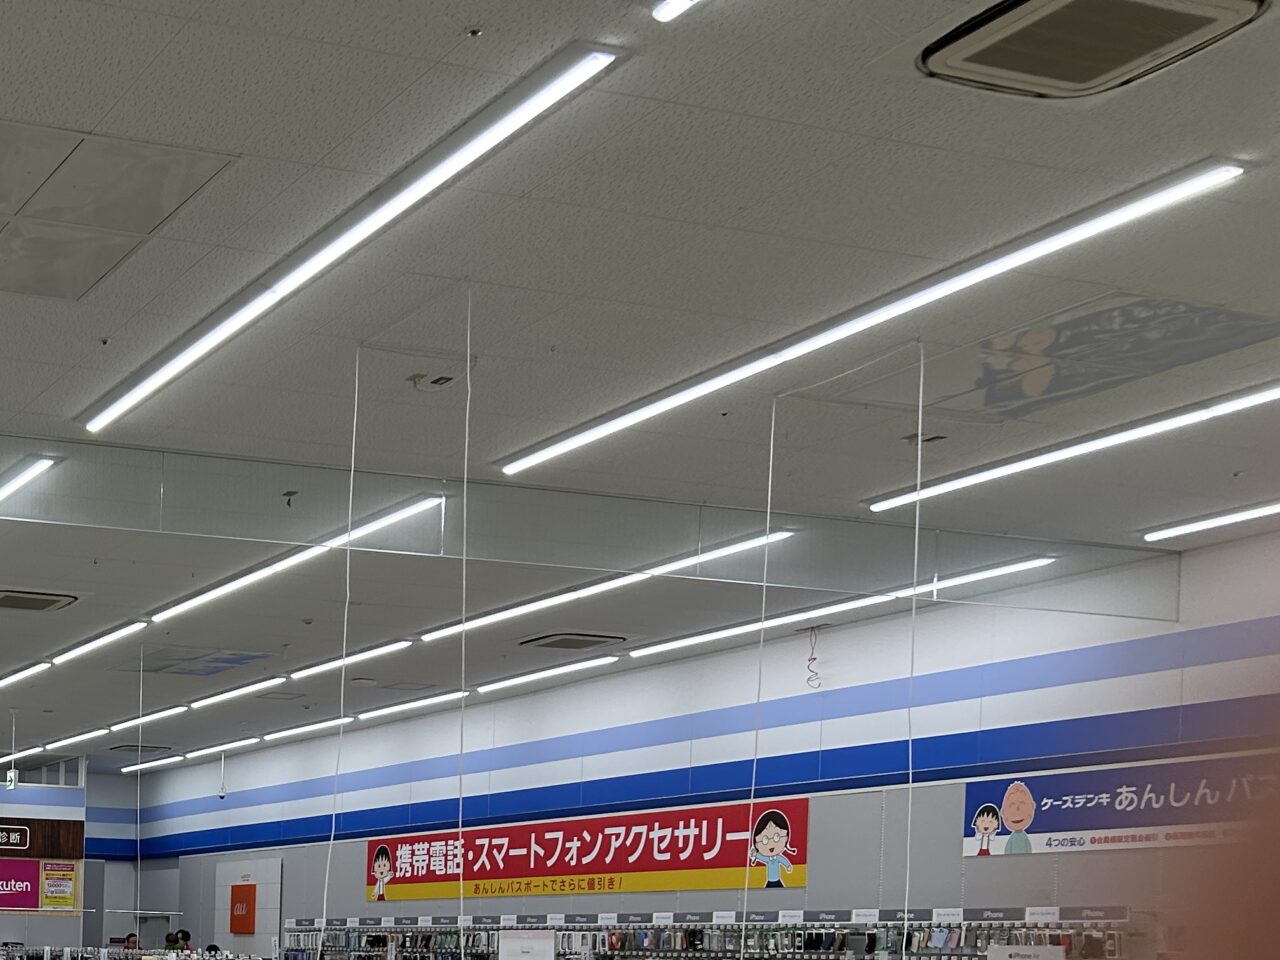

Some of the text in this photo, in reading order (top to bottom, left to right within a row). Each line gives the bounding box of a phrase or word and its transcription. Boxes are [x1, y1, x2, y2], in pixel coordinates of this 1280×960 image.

[1041, 792, 1110, 811] ケーズデンキ
[395, 816, 750, 878] 携帯電話・スマートフォンアクセサリー
[1045, 835, 1086, 848] 4つの安心
[233, 903, 248, 916] au
